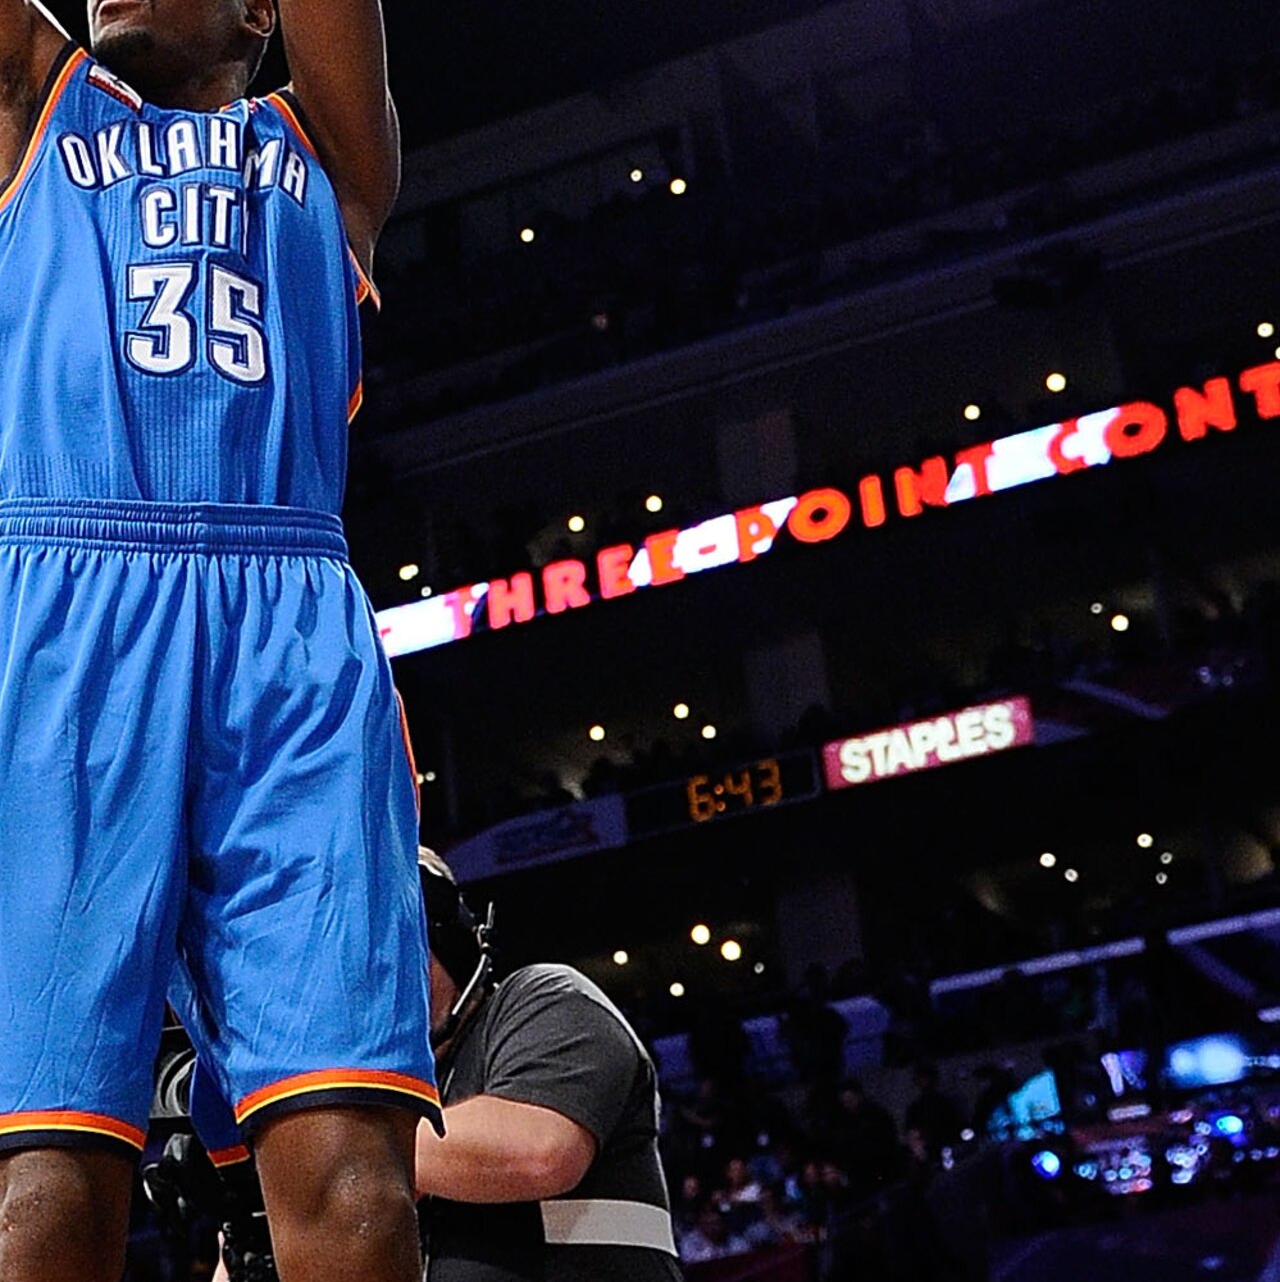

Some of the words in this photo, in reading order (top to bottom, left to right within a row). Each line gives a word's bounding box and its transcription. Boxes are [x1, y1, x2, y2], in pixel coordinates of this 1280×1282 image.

[57, 115, 310, 210] OKLAHMA
[140, 182, 249, 264] CIT
[124, 258, 271, 388] 35
[839, 703, 1014, 784] STAPLES
[686, 758, 782, 822] 6:43
